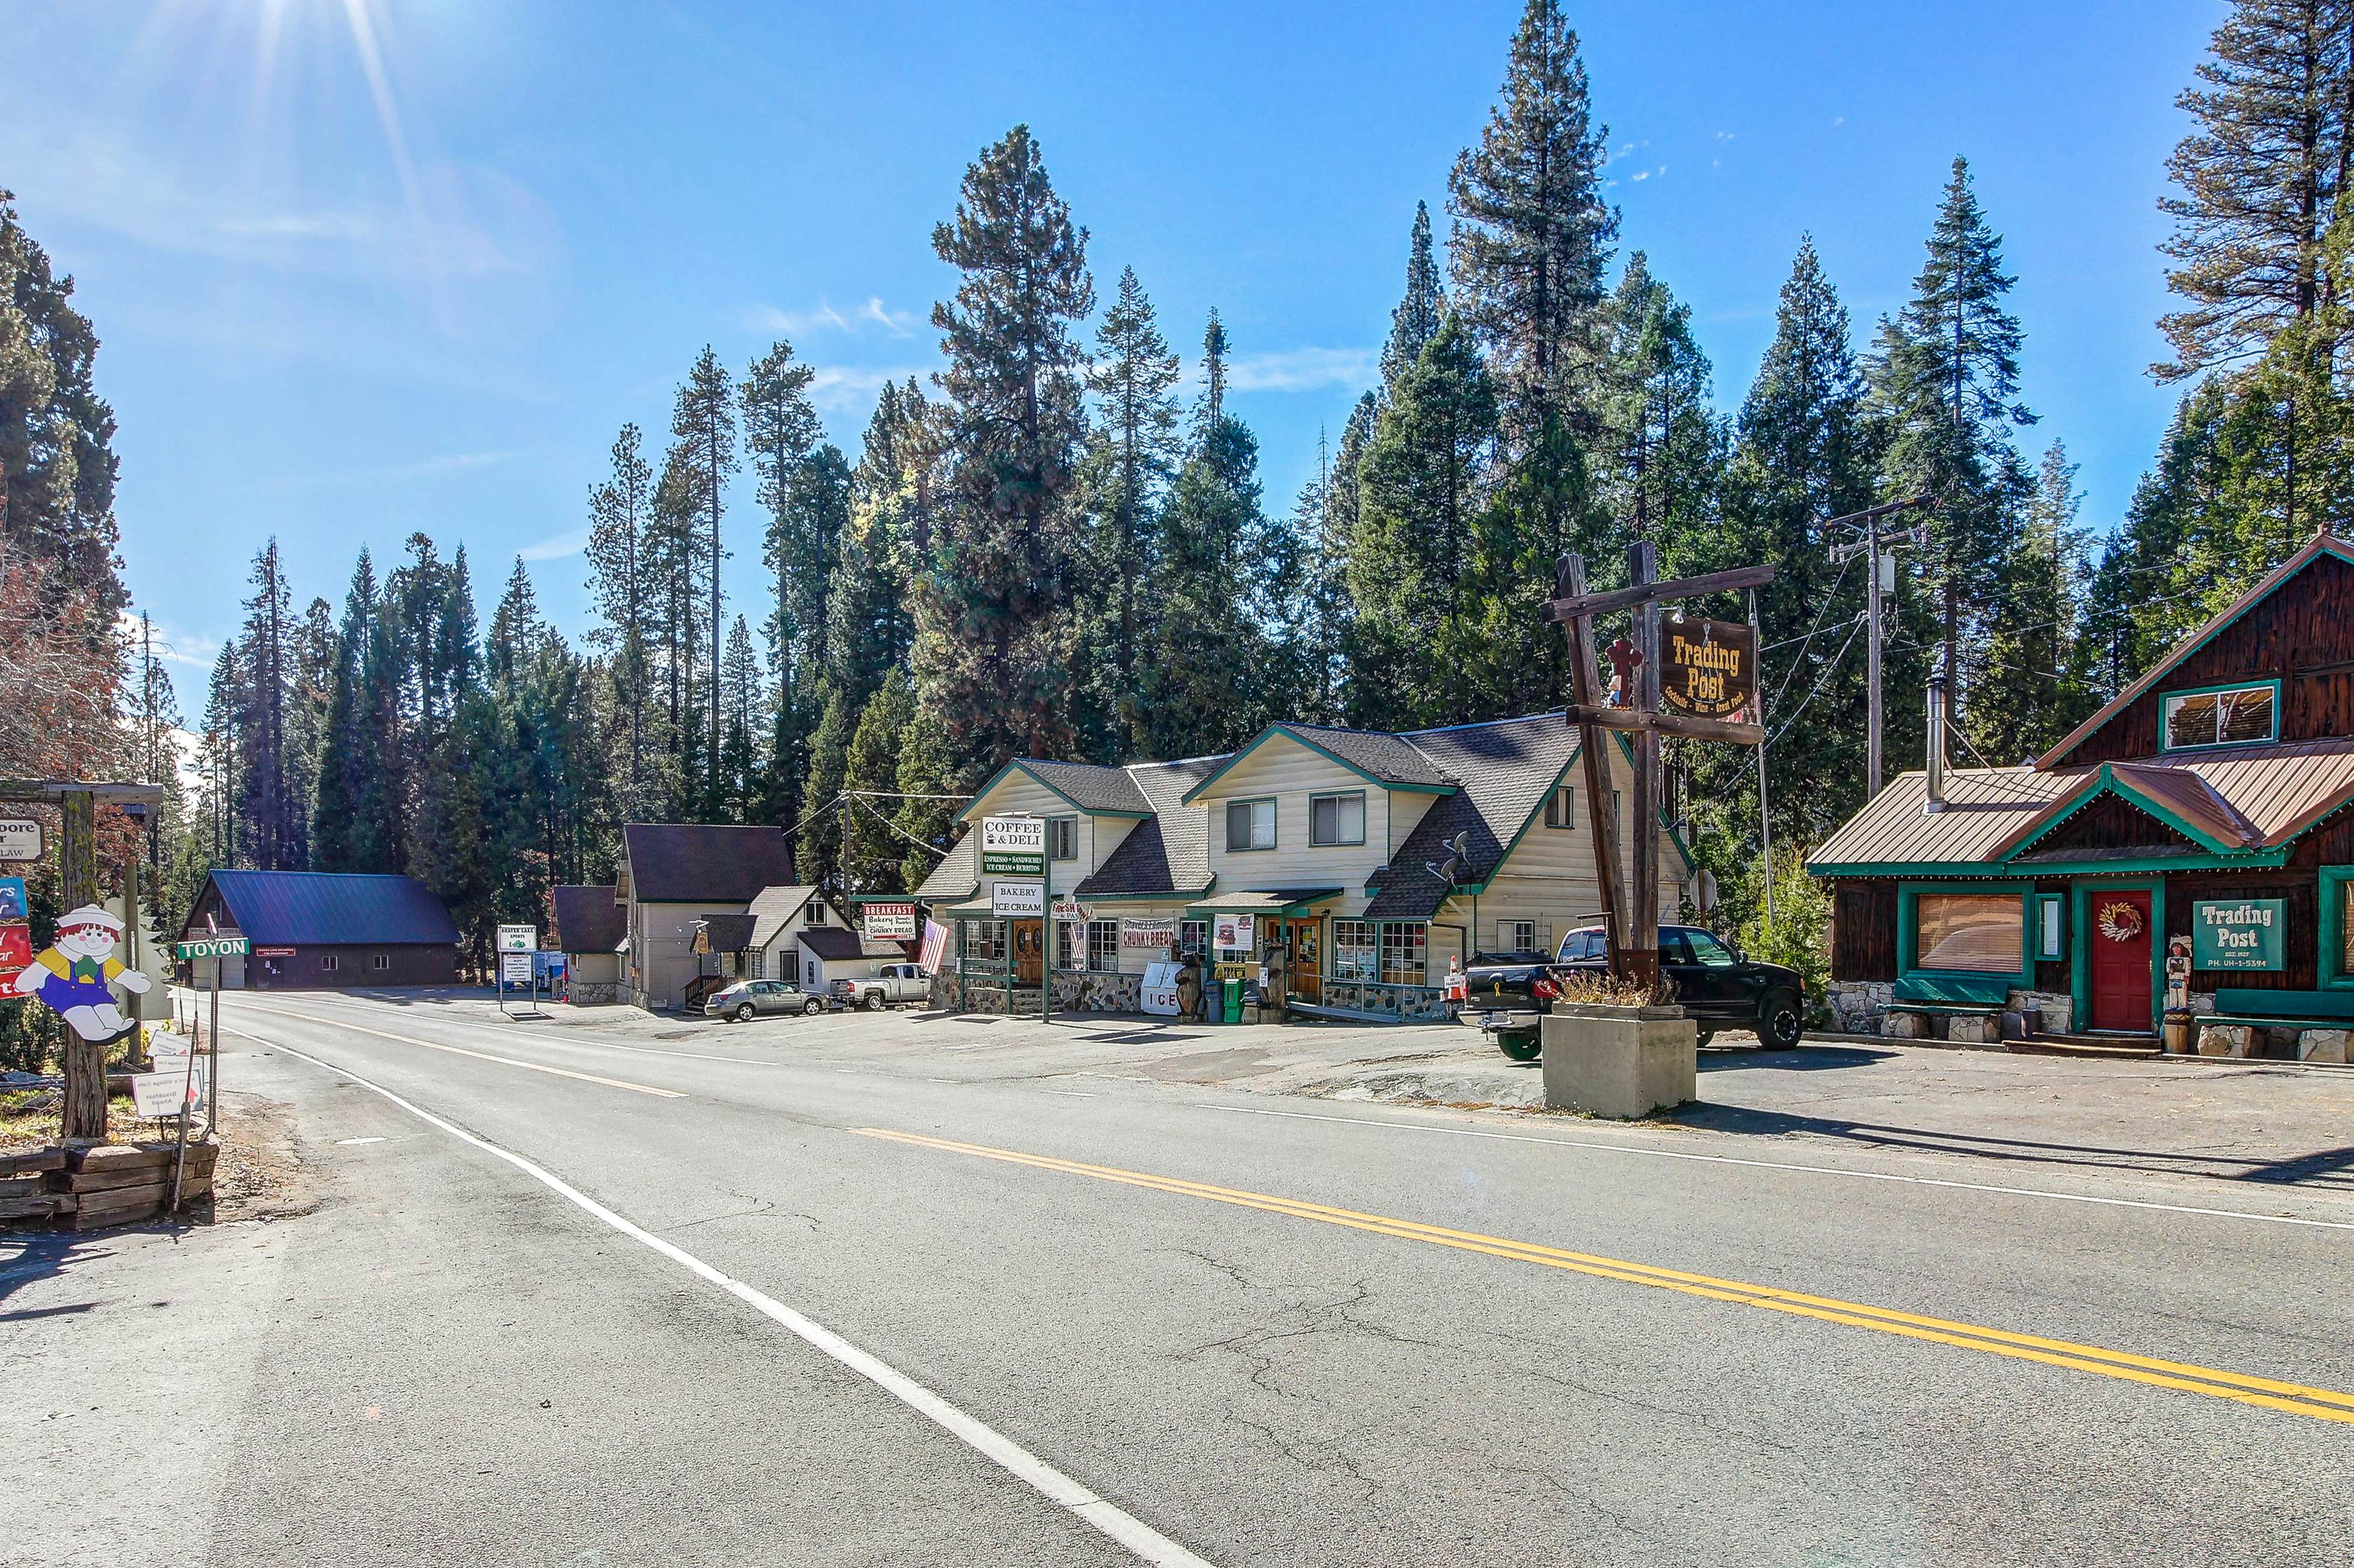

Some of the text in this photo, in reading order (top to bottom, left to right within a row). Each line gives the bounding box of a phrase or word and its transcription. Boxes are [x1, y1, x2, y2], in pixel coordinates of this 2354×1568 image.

[1673, 635, 1740, 677] Trading
[1686, 667, 1724, 699] Post
[1665, 686, 1744, 713] Cocktails Wine Great Food
[985, 821, 1041, 833] COFFEE
[998, 835, 1039, 845] & DELI
[1000, 888, 1037, 896] BAKERY
[866, 906, 912, 914] BREAKFAST
[1011, 903, 1042, 911] CREAM
[1053, 902, 1075, 913] FRESH
[869, 916, 893, 925] Bakery
[2202, 905, 2273, 926] Trading
[1123, 931, 1174, 946] CHUNKY BREAD
[2217, 928, 2258, 948] Post
[182, 940, 246, 957] TOYON
[1150, 993, 1176, 1006] ICE
